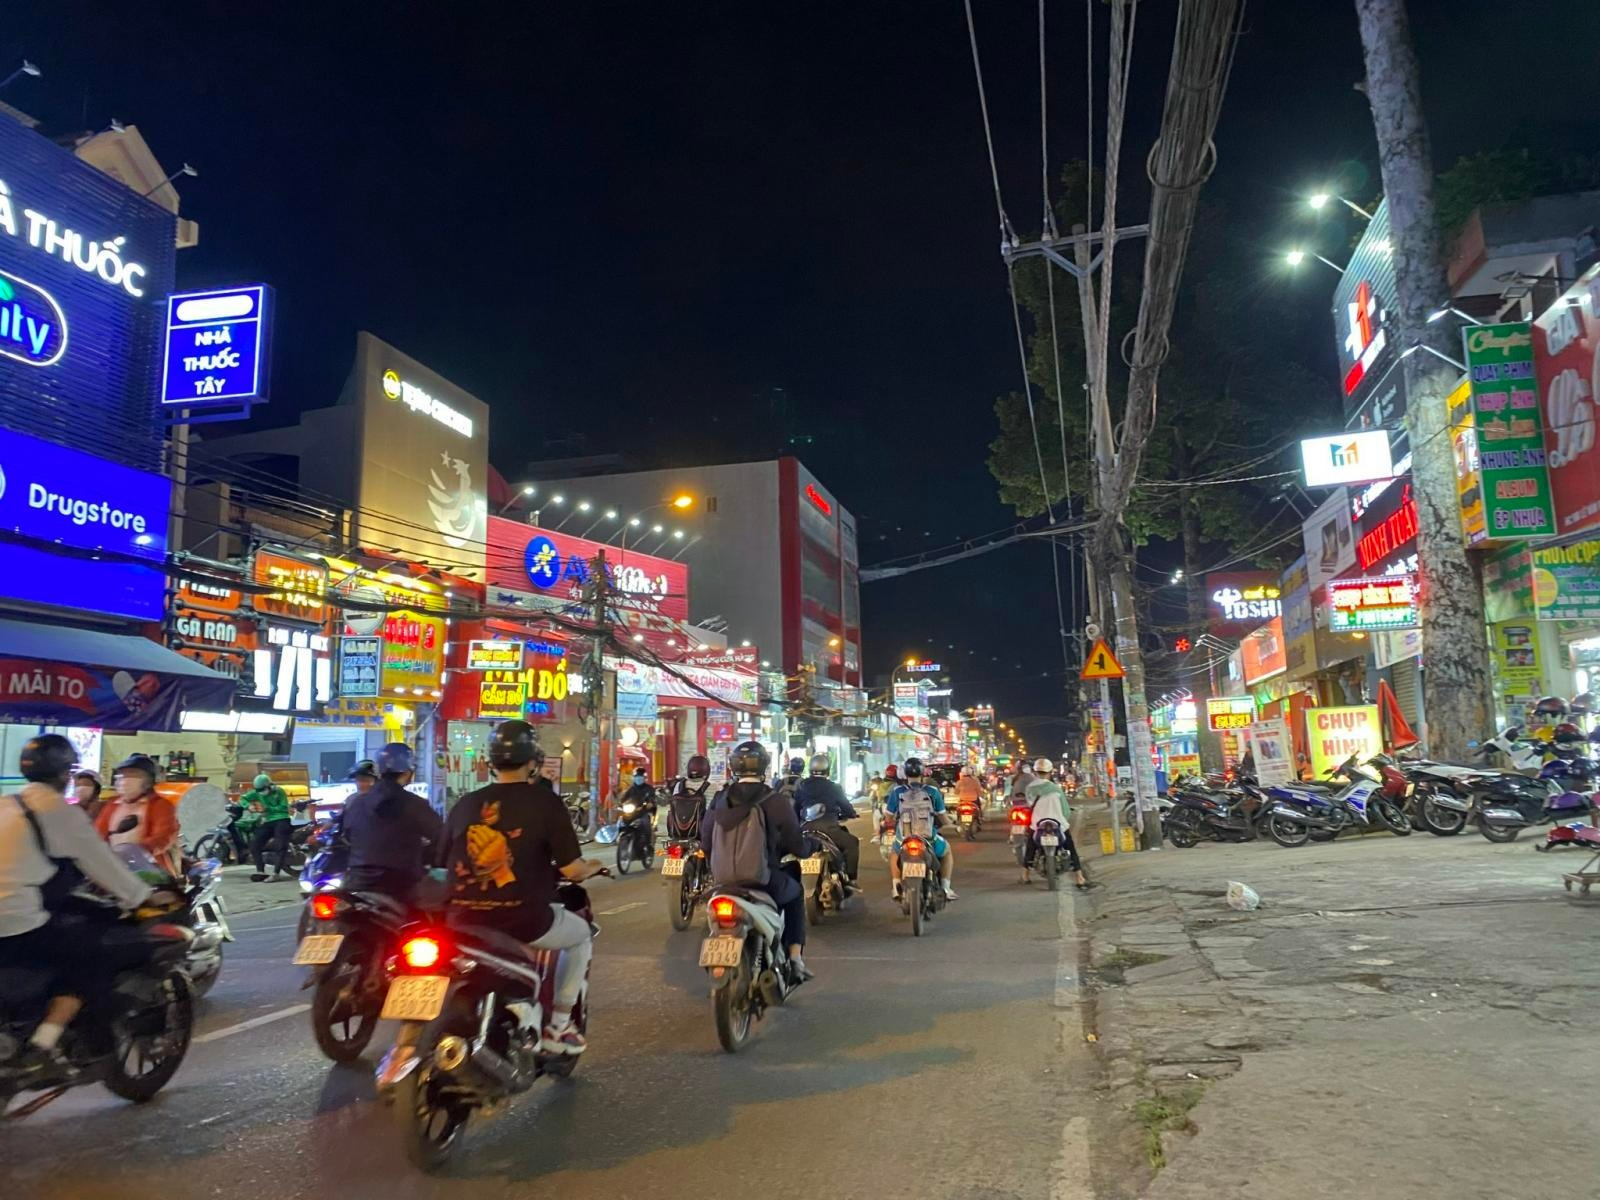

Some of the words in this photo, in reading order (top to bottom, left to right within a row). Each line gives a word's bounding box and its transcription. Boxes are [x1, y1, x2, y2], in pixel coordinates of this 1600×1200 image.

[25, 209, 145, 297] THUỐC
[183, 347, 240, 372] THUỐC
[1473, 364, 1499, 383] QUAY
[1503, 361, 1532, 379] PHIM
[1496, 479, 1538, 498] ALBUM
[28, 483, 146, 534] Drugstore
[57, 675, 84, 700] TO
[1317, 711, 1368, 734] CHỤP
